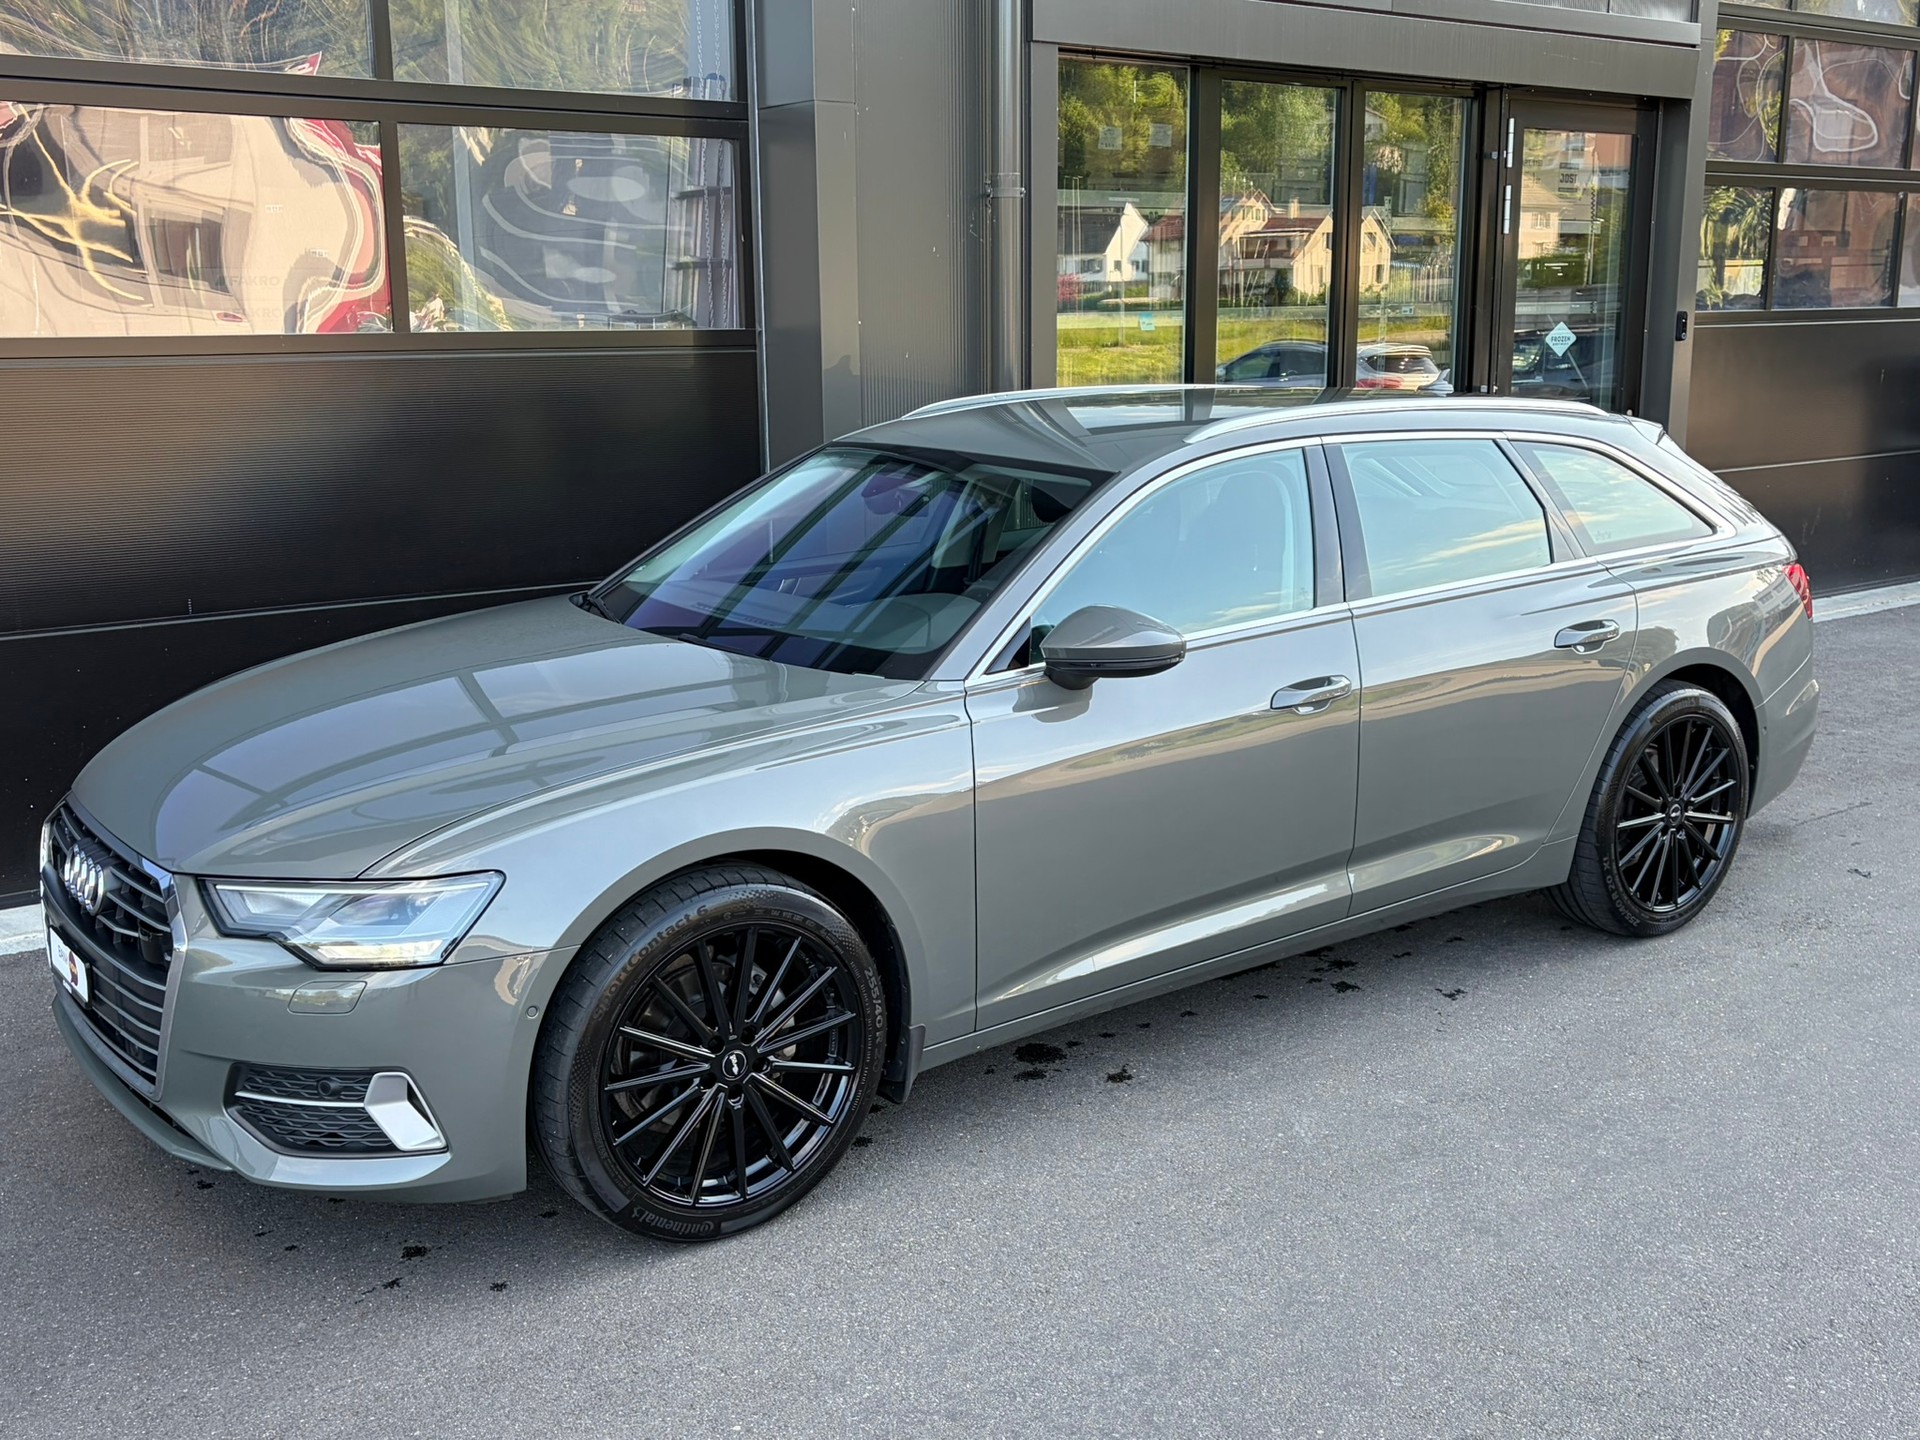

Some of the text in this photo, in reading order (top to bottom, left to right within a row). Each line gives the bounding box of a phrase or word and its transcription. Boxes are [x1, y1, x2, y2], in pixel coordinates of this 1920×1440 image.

[1550, 335, 1571, 343] FROZEN
[1606, 875, 1616, 891] 20
[696, 904, 709, 917] 6
[863, 966, 884, 1029] 255/40
[875, 1031, 884, 1043] R
[638, 1209, 715, 1236] Continental
